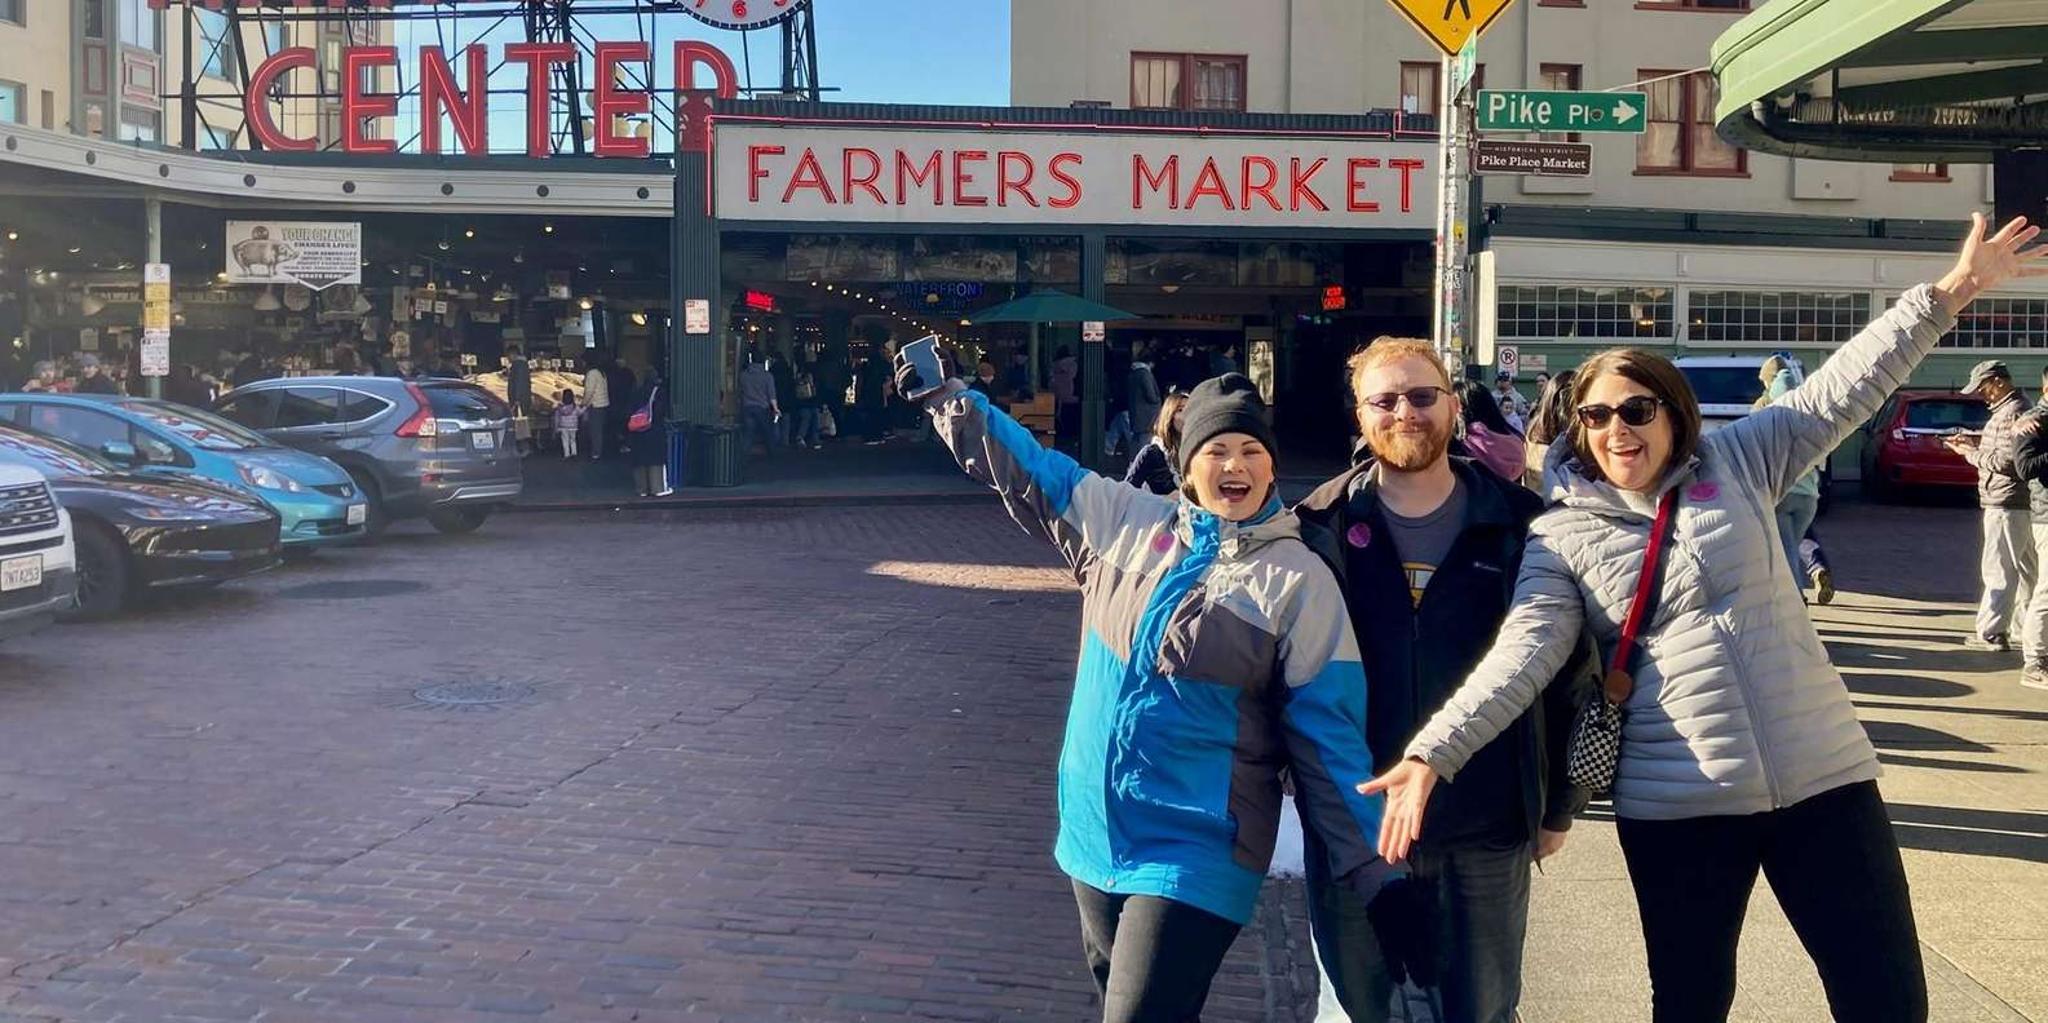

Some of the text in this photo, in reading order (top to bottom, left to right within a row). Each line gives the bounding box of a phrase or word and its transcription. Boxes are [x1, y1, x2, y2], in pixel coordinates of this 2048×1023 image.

[1488, 93, 1552, 125] Pike
[1480, 155, 1587, 169] Pike Place Market
[748, 145, 1426, 213] FARMERS MARKET
